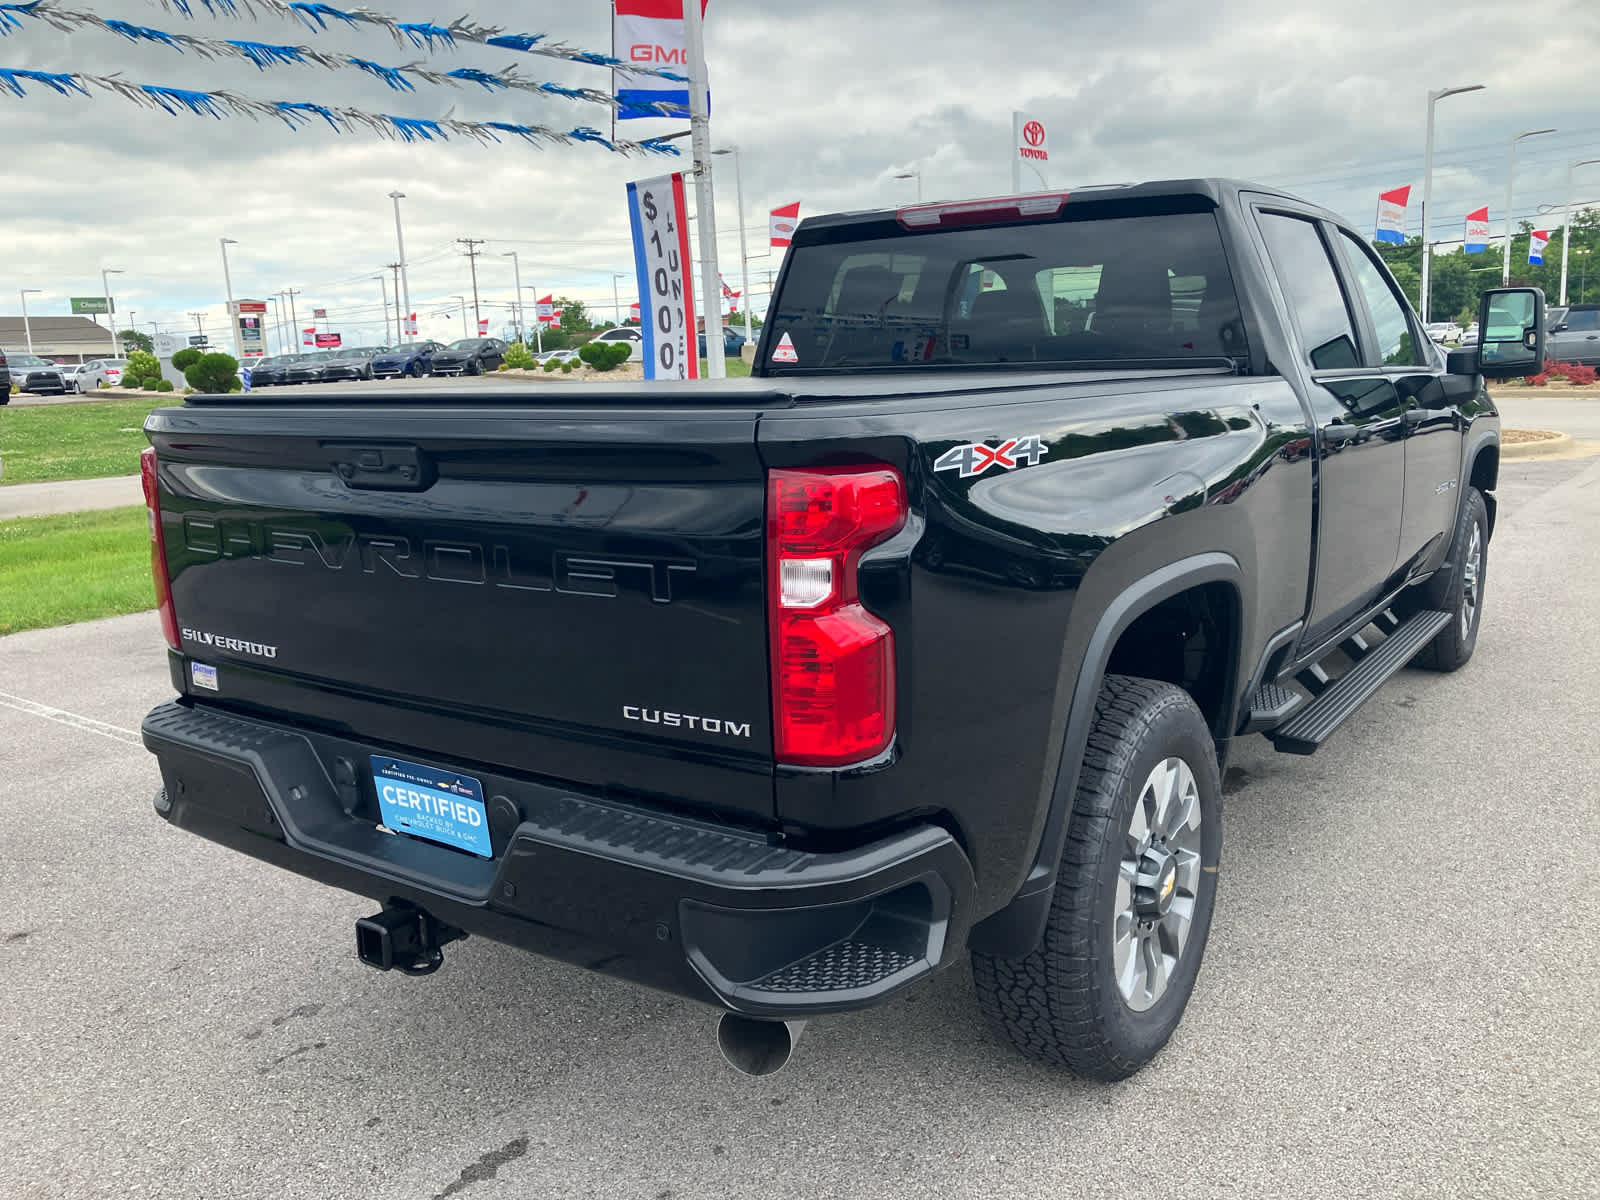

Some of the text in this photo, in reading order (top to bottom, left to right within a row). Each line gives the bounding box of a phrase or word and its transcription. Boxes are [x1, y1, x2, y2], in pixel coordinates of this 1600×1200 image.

[1019, 147, 1048, 160] TOYOTA
[182, 512, 698, 604] CHEVROLET
[182, 627, 278, 658] SILVERADO
[623, 705, 752, 738] CUSTOM
[382, 785, 482, 827] CERTIFIED
